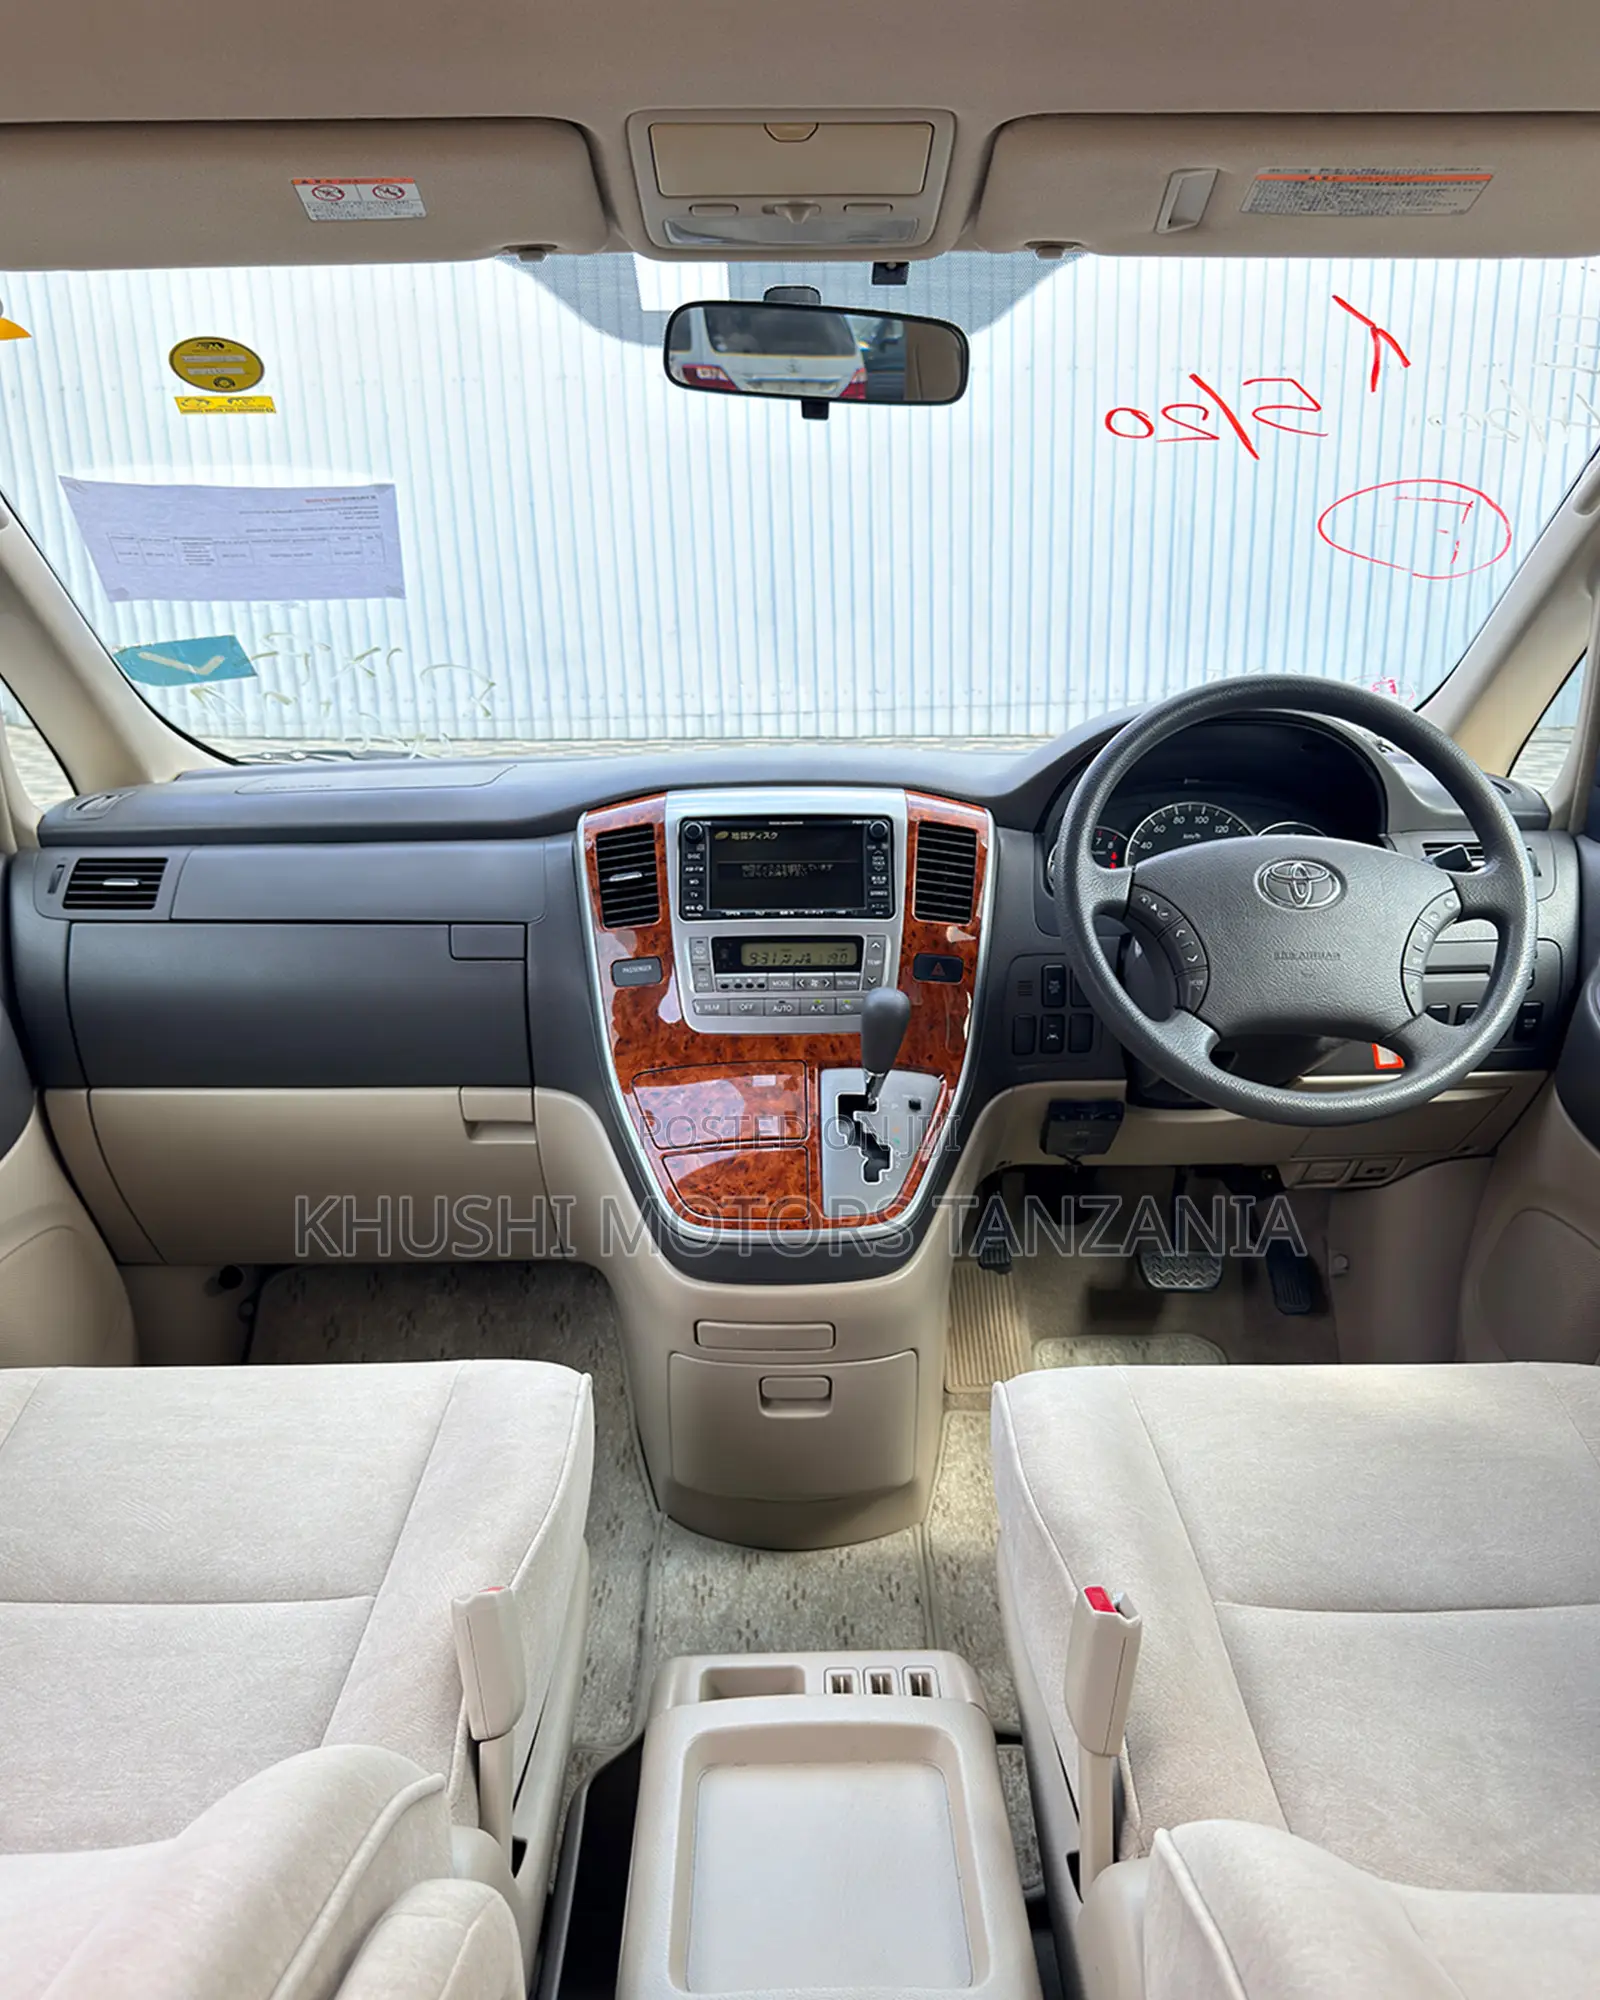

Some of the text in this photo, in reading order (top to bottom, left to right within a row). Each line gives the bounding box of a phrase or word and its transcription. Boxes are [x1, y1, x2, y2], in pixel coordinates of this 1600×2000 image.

[1172, 816, 1186, 825] 80
[1194, 816, 1210, 825] 100
[1153, 824, 1167, 834] 60
[1214, 824, 1229, 834] 120
[1140, 841, 1153, 850] 40
[772, 1004, 792, 1013] AUTO
[810, 1004, 825, 1013] A/C
